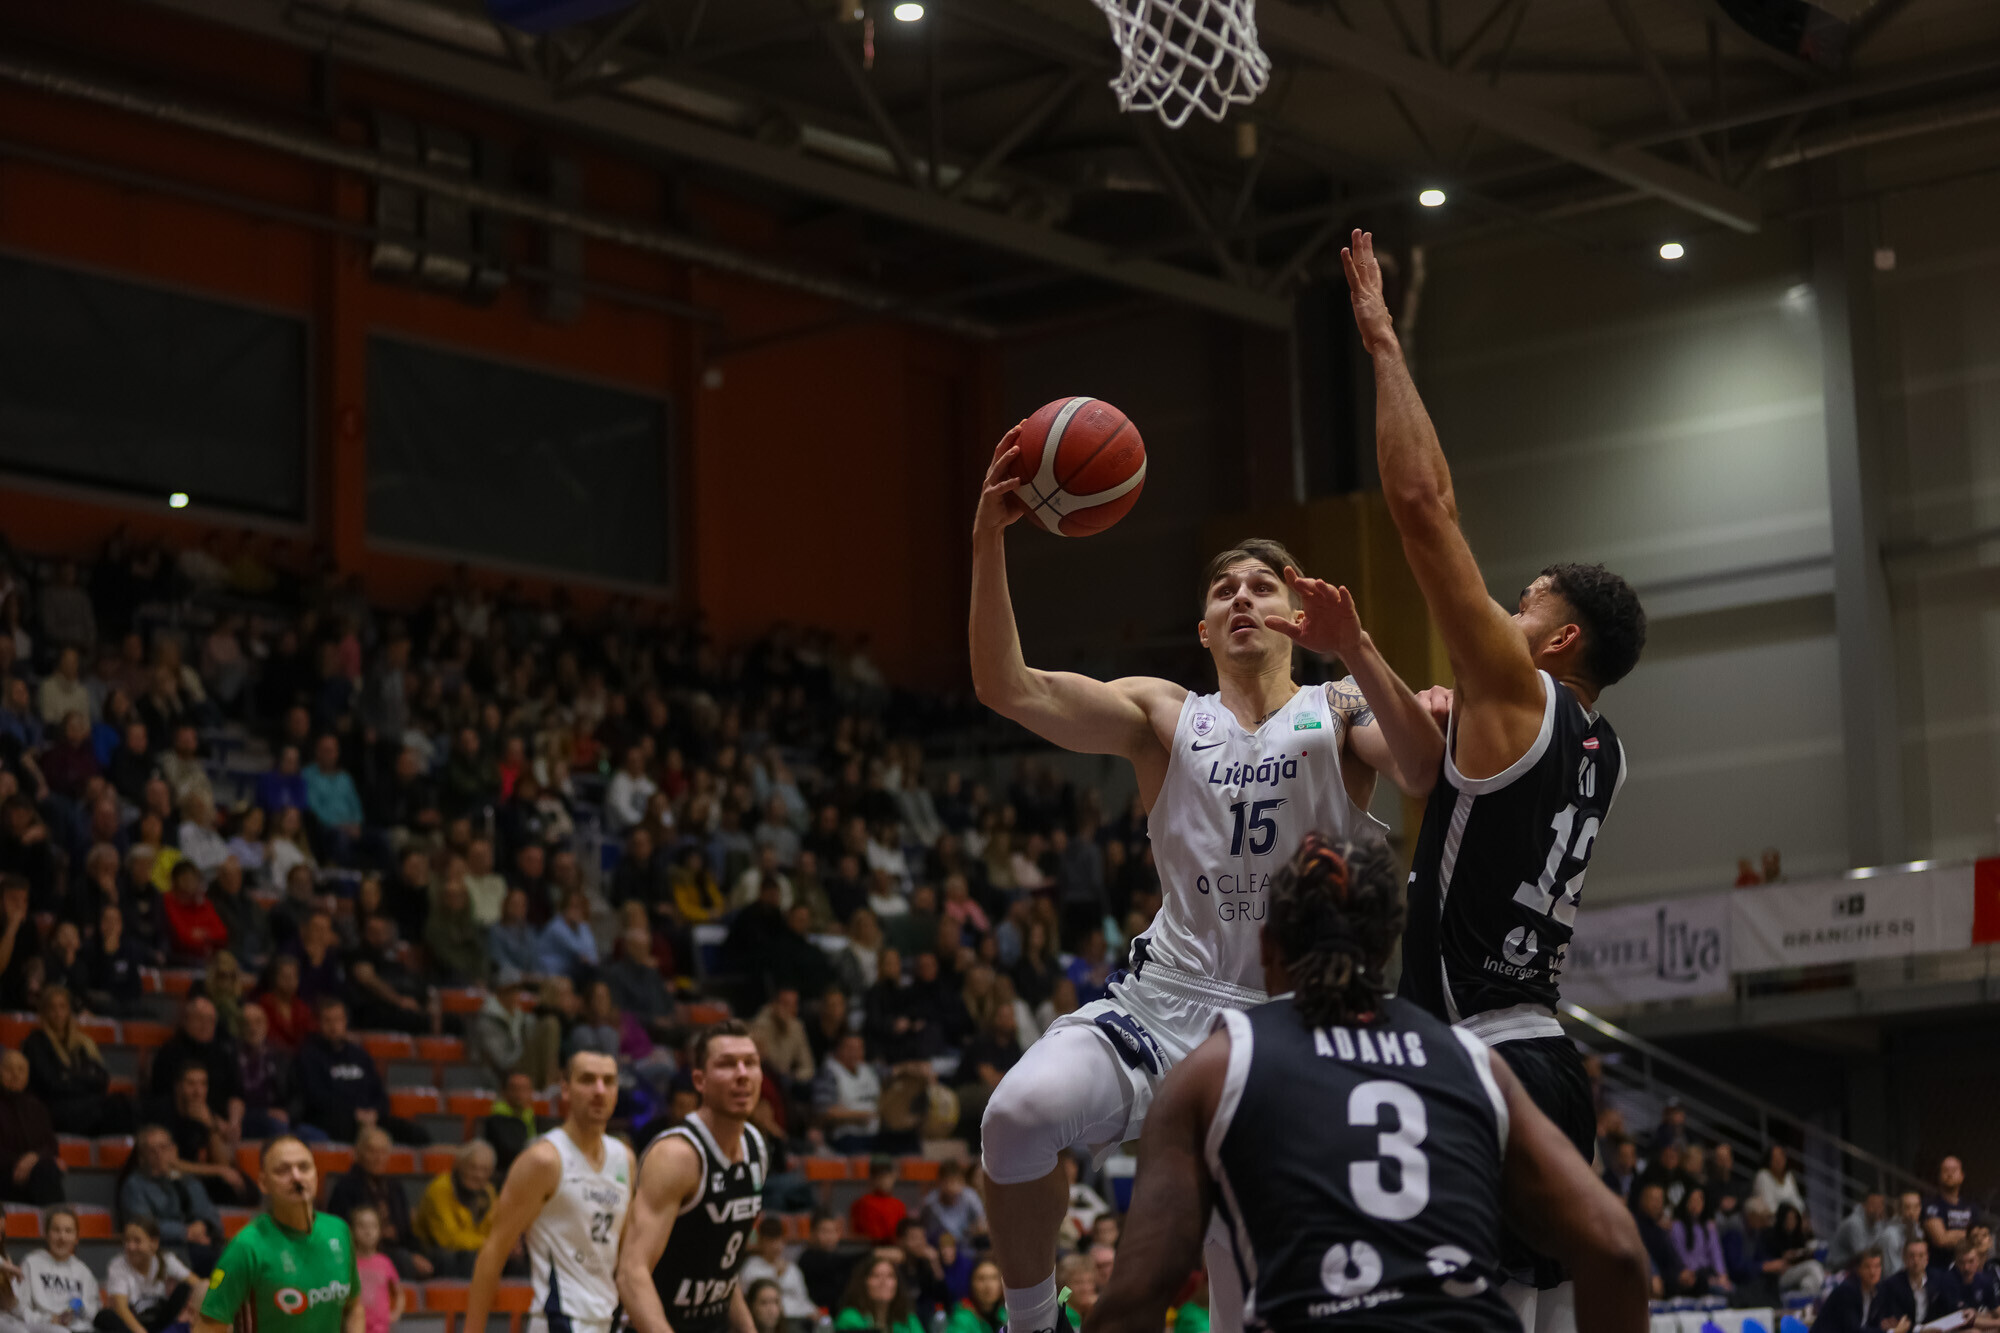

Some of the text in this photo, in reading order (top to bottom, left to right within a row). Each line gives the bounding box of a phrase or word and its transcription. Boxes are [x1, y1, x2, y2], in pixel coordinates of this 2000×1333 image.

[1229, 798, 1288, 858] 15
[1512, 803, 1601, 929] 12
[1313, 1025, 1428, 1068] ADAMS
[1347, 1079, 1430, 1221] 3
